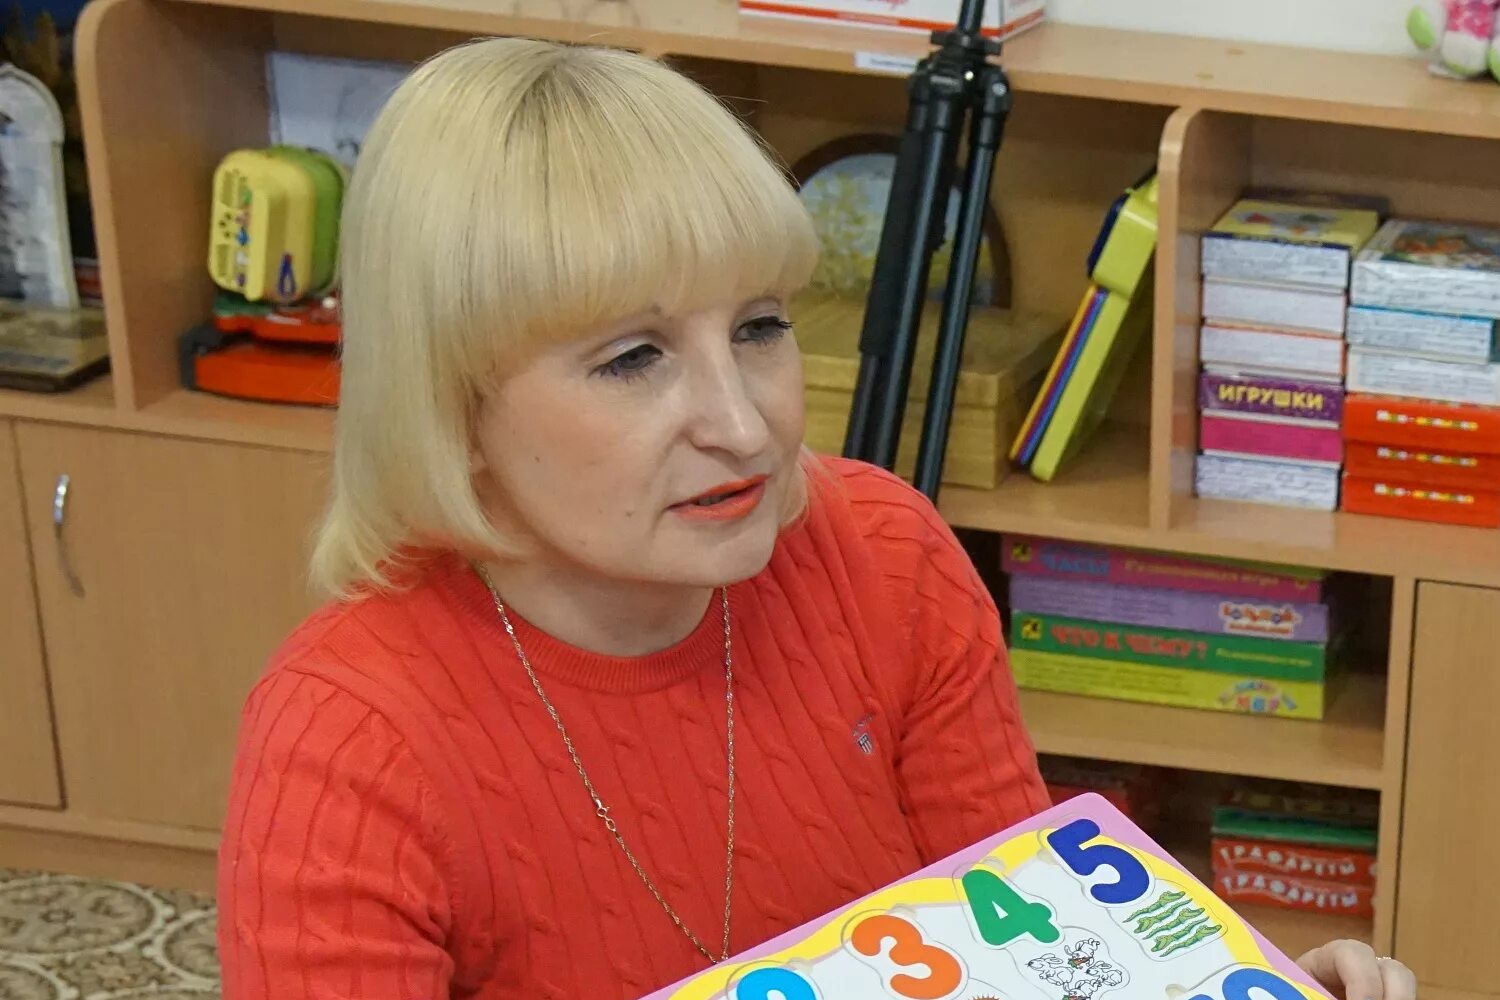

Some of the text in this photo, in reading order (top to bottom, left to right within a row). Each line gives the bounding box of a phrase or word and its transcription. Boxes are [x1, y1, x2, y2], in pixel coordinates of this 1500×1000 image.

[1219, 384, 1323, 411] ИГРУШКИ
[1047, 818, 1150, 904] 5
[962, 869, 1061, 946] 4
[851, 914, 962, 1000] 3
